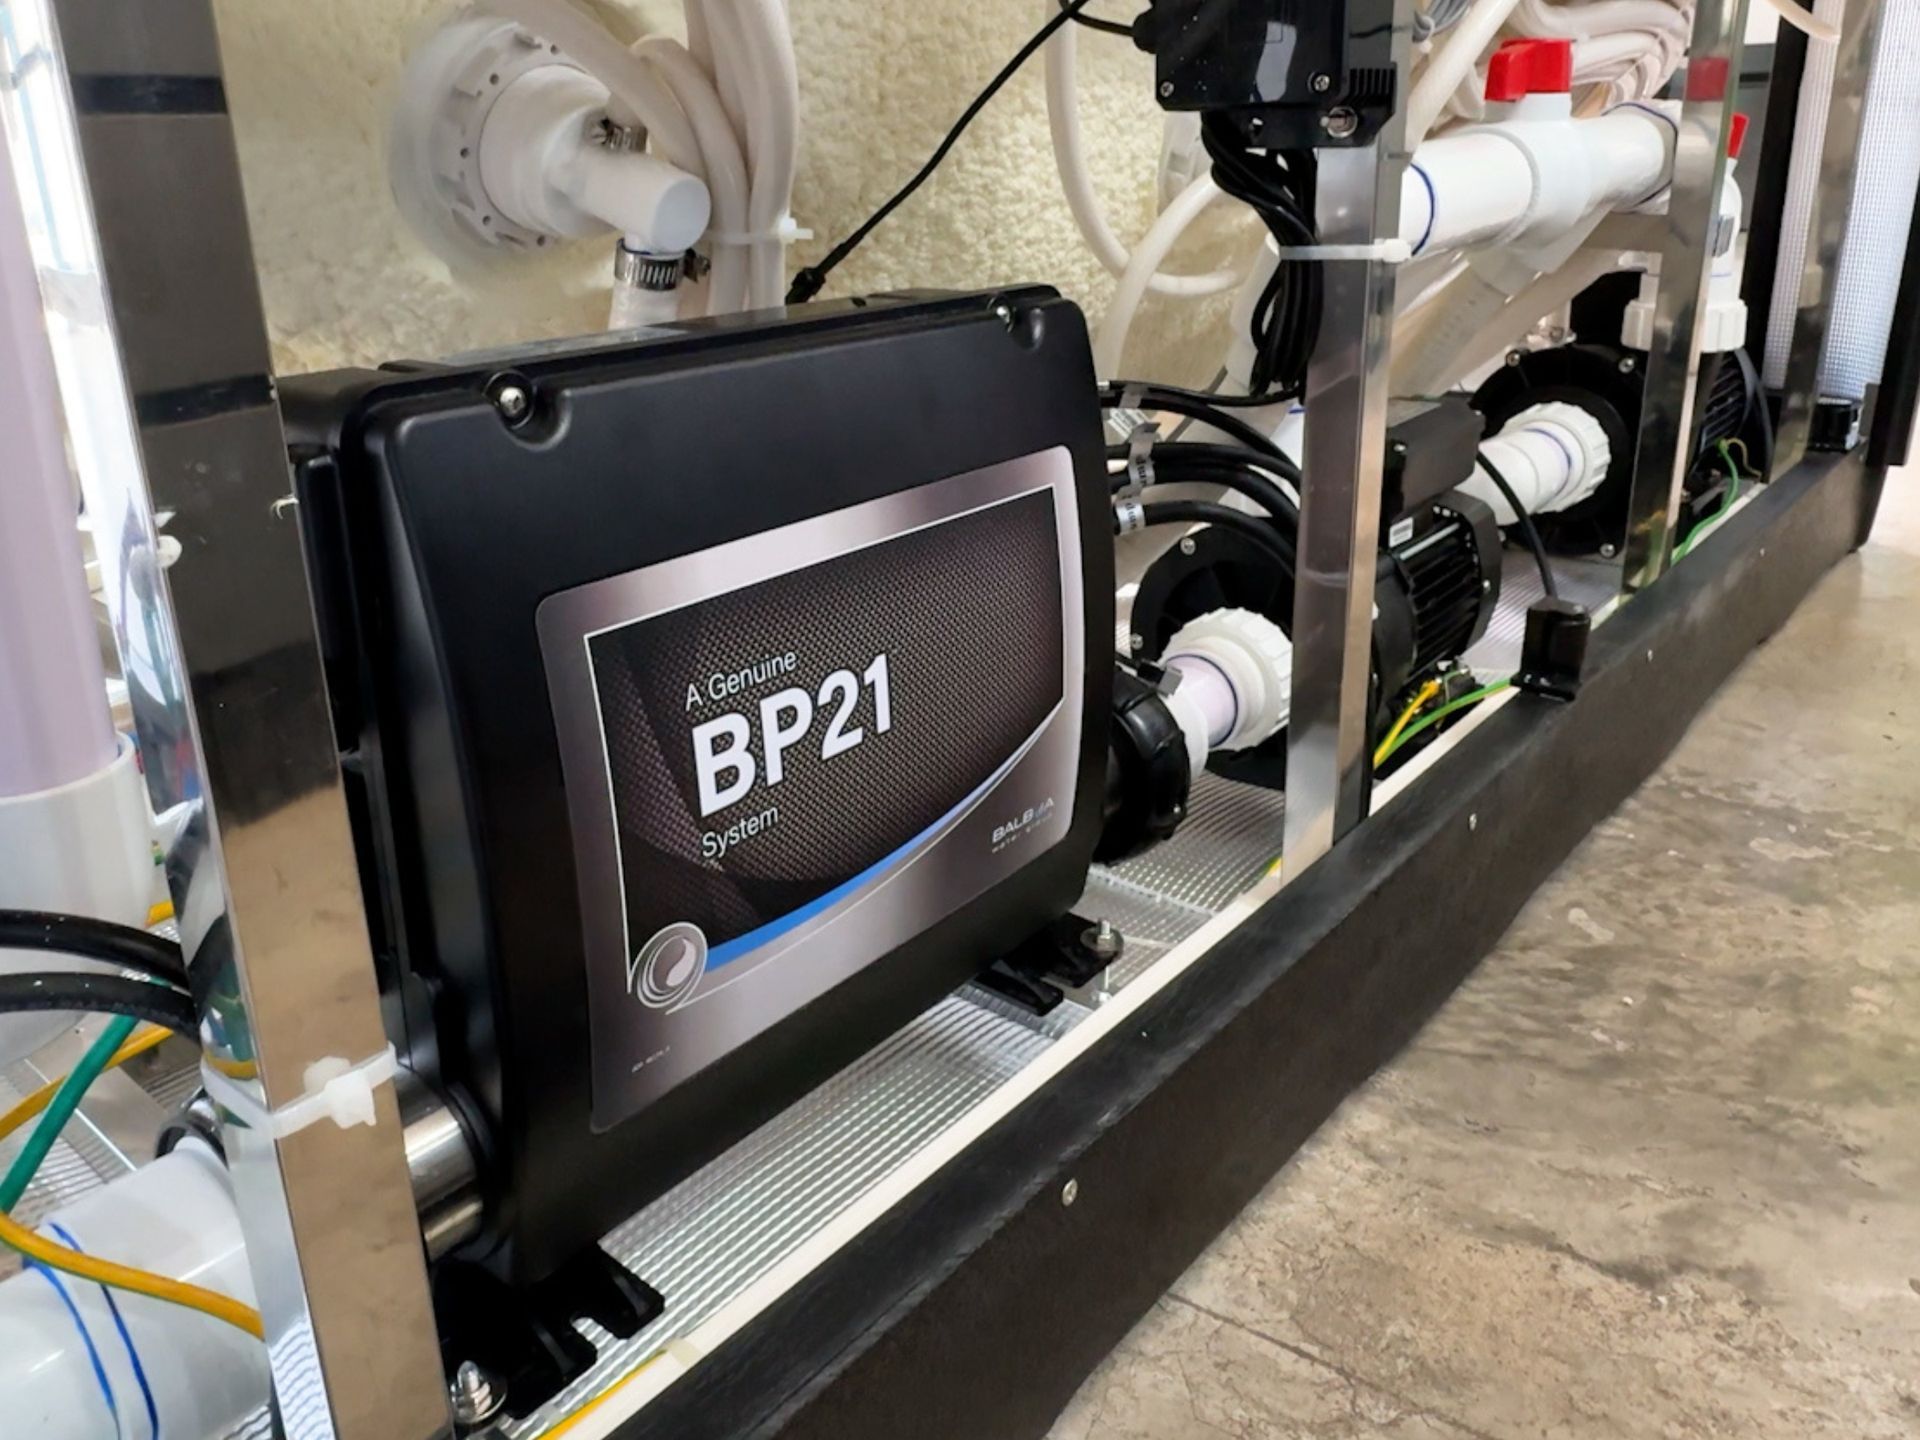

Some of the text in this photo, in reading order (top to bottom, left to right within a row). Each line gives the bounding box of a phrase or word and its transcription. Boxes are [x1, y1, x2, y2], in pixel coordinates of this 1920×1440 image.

[685, 651, 798, 712] A Genuine
[692, 653, 892, 818] BP21
[701, 806, 779, 859] System
